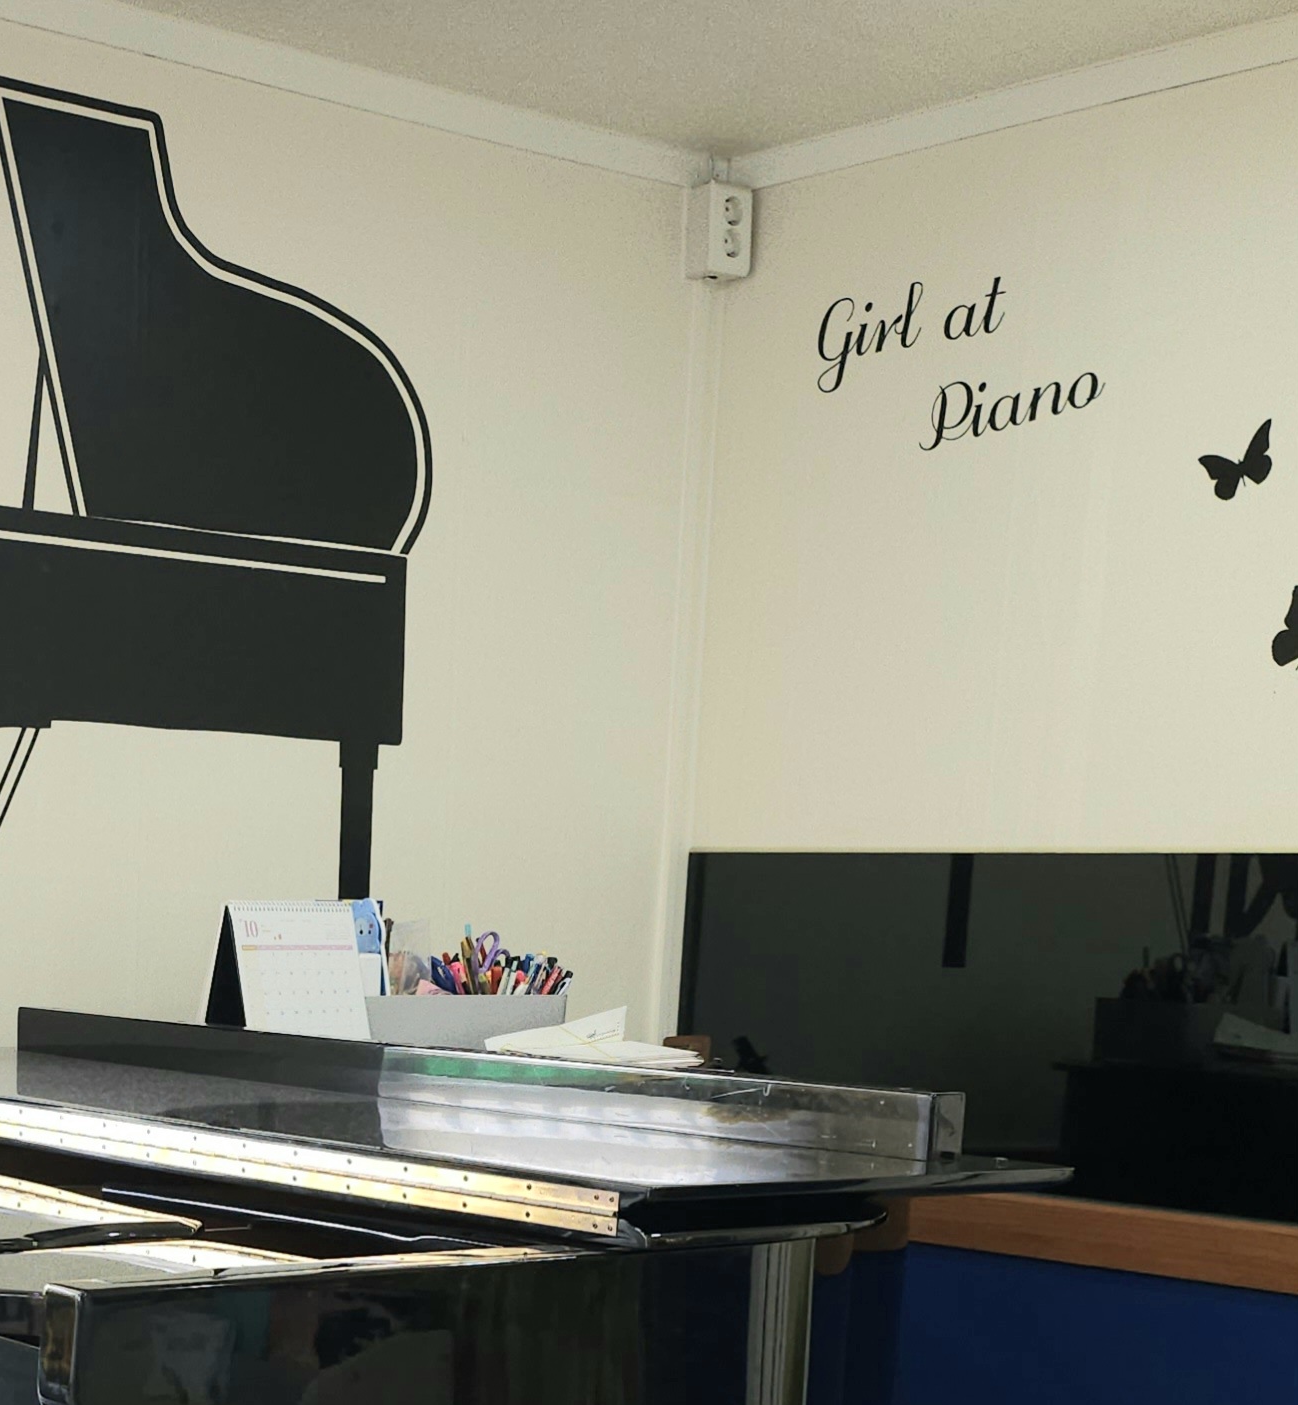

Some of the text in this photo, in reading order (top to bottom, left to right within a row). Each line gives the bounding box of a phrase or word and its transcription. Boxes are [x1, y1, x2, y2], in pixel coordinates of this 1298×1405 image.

[817, 276, 1007, 394] Girl at
[918, 371, 1106, 451] Piano
[243, 920, 259, 938] 10
